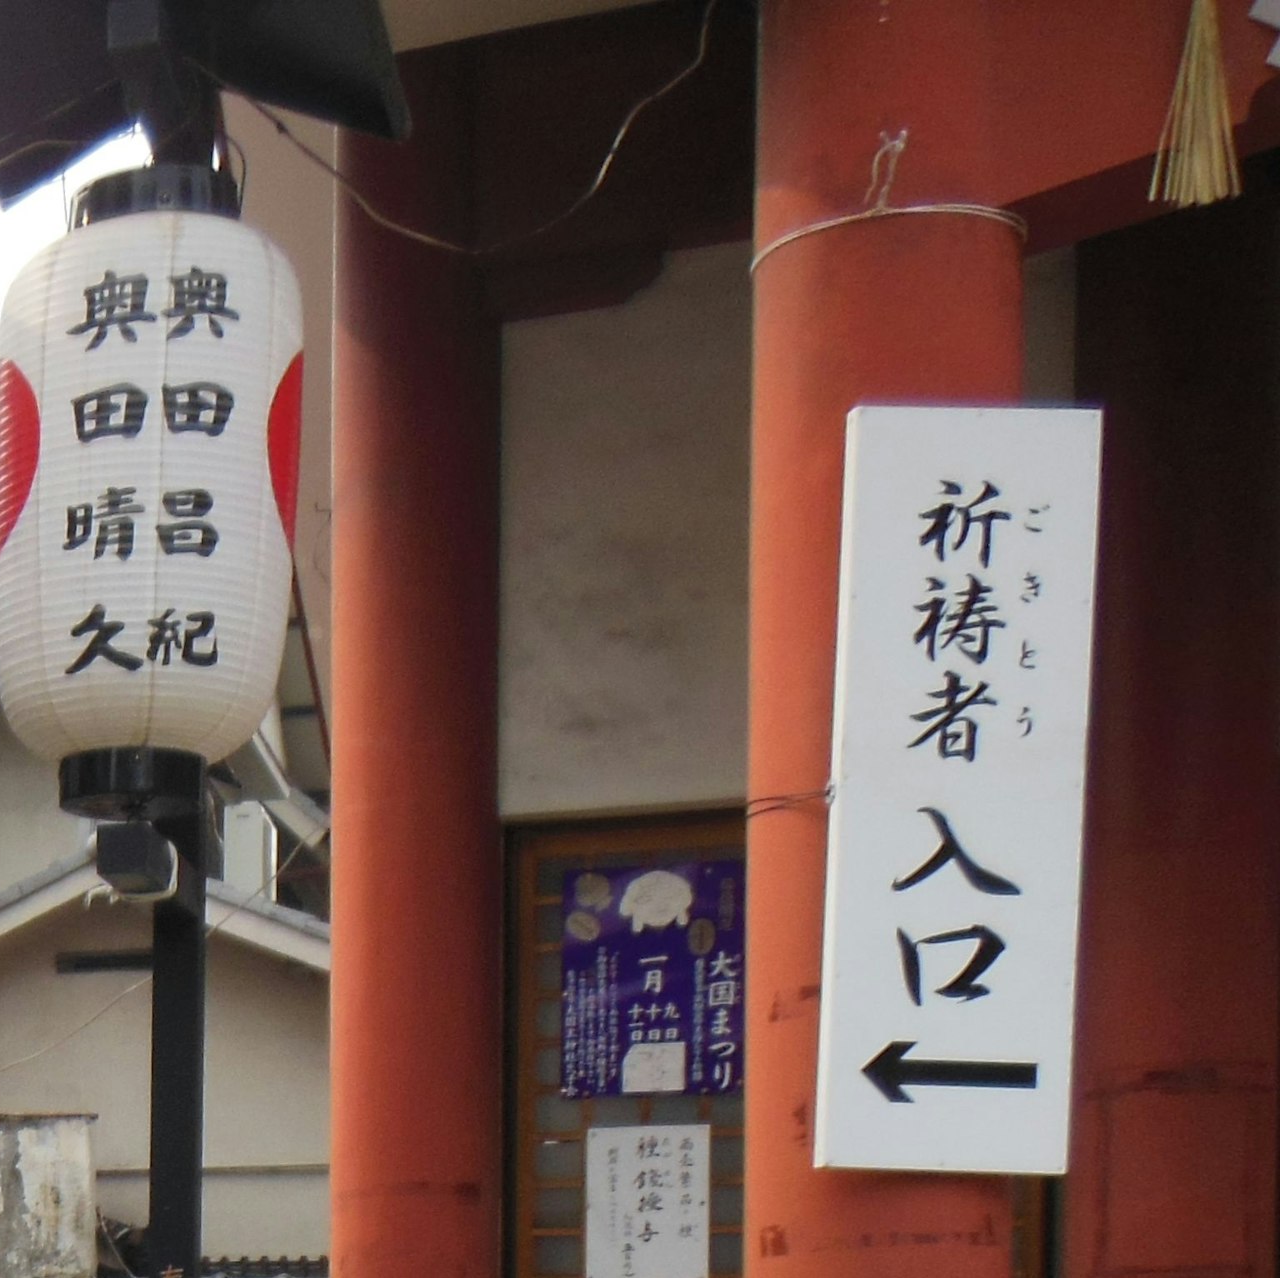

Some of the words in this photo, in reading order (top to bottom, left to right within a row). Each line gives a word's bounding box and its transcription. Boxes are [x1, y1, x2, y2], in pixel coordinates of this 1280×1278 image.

[62, 268, 157, 676] 奥田晴久
[906, 478, 1012, 763] 祈祷者
[1016, 503, 1051, 738] ごきとう
[638, 954, 669, 994] 一月
[891, 805, 1022, 1008] 入口
